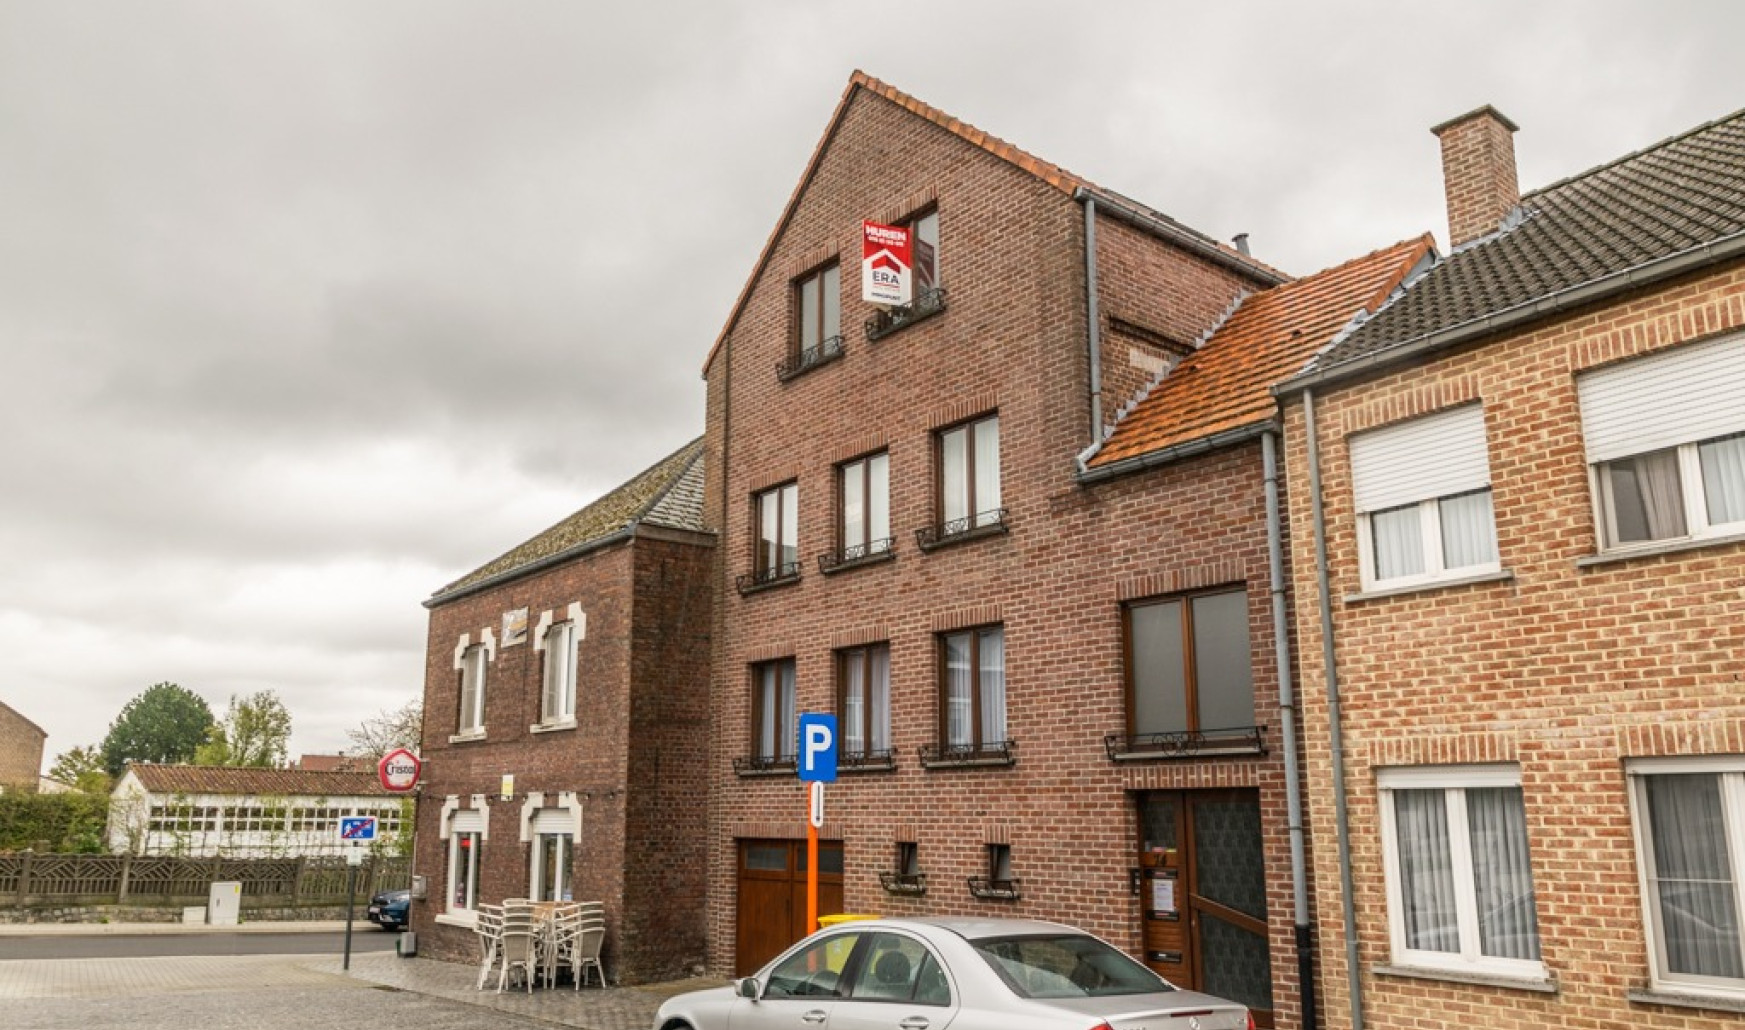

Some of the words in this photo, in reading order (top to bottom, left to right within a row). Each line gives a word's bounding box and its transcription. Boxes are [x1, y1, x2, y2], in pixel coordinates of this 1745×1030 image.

[865, 224, 907, 241] HUREN
[872, 270, 899, 284] ERA
[805, 723, 832, 771] P
